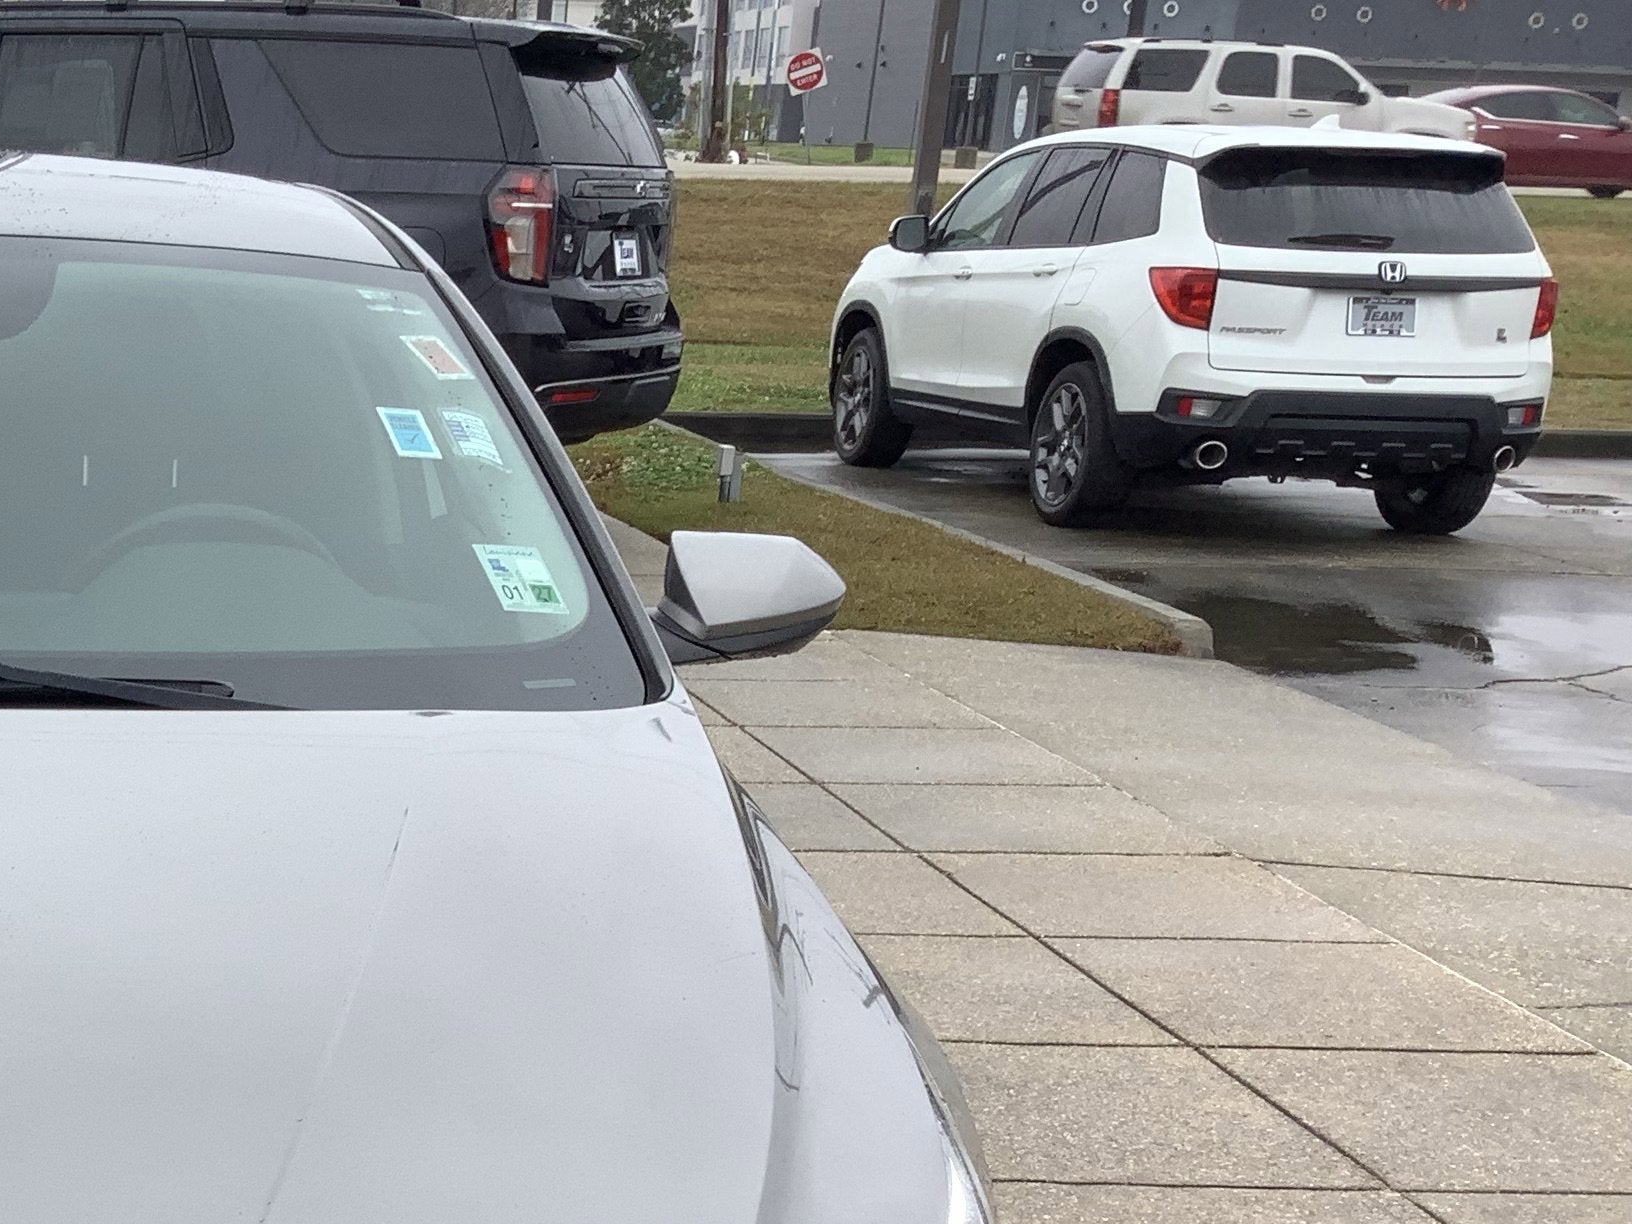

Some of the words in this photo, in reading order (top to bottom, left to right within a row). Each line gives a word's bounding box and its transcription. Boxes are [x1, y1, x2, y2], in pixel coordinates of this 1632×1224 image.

[790, 61, 801, 71] DO
[801, 56, 816, 66] NOT
[796, 73, 818, 87] ENTER
[501, 584, 524, 601] 01
